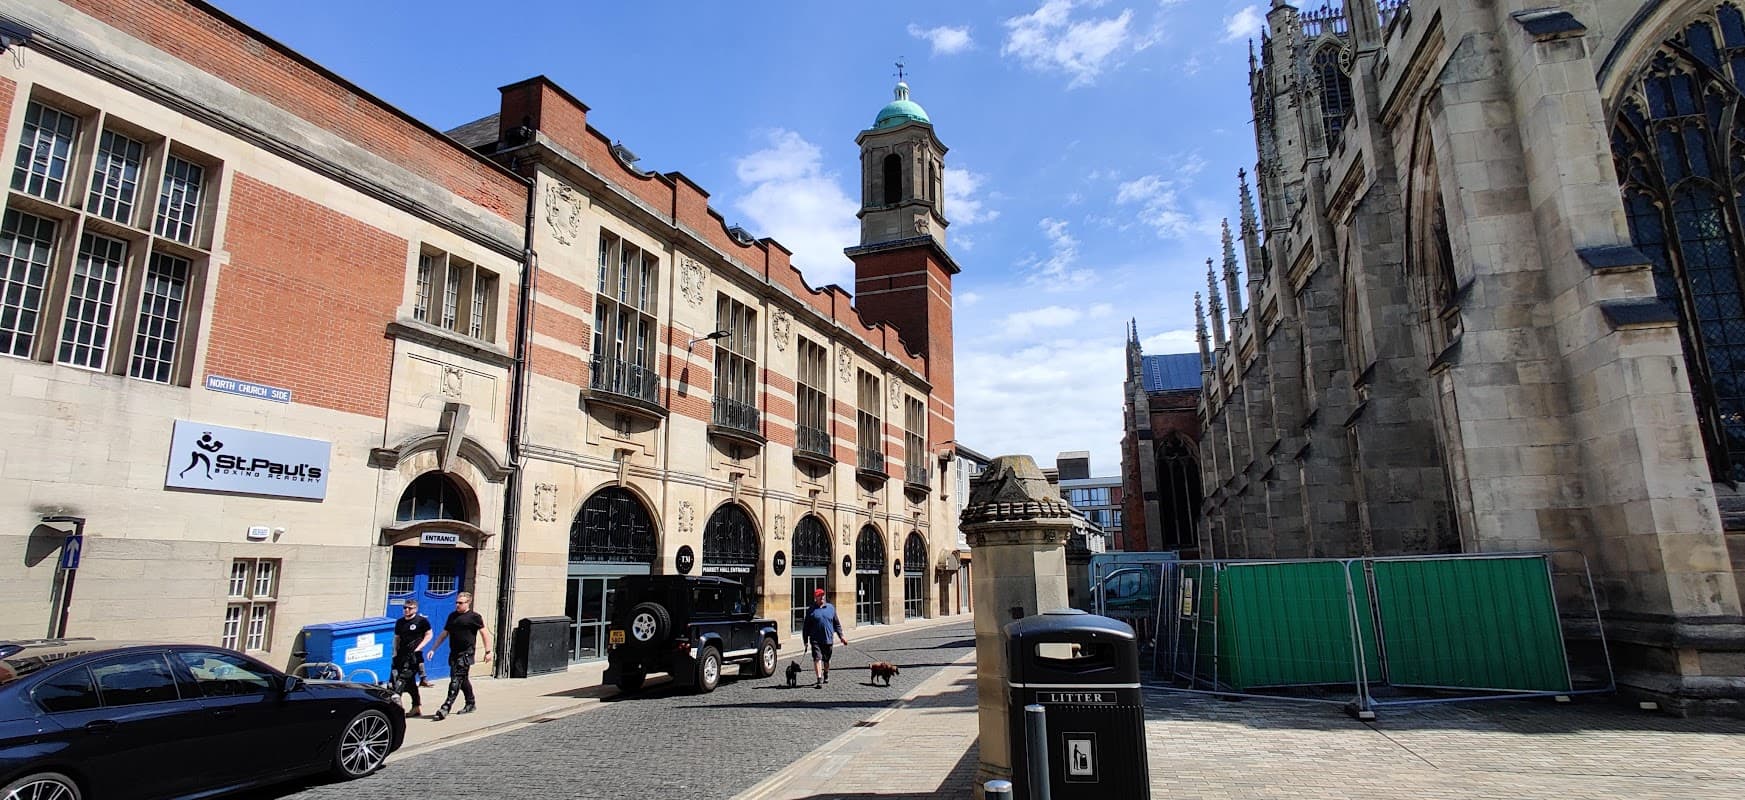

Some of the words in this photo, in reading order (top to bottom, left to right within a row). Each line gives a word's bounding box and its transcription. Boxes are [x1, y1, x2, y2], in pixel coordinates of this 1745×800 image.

[209, 377, 235, 391] NORTH
[238, 384, 268, 397] CHURCH
[271, 390, 289, 401] SIDE
[214, 468, 260, 478] BOXING
[268, 474, 321, 483] ACADEMY
[1051, 693, 1102, 702] LITTER
